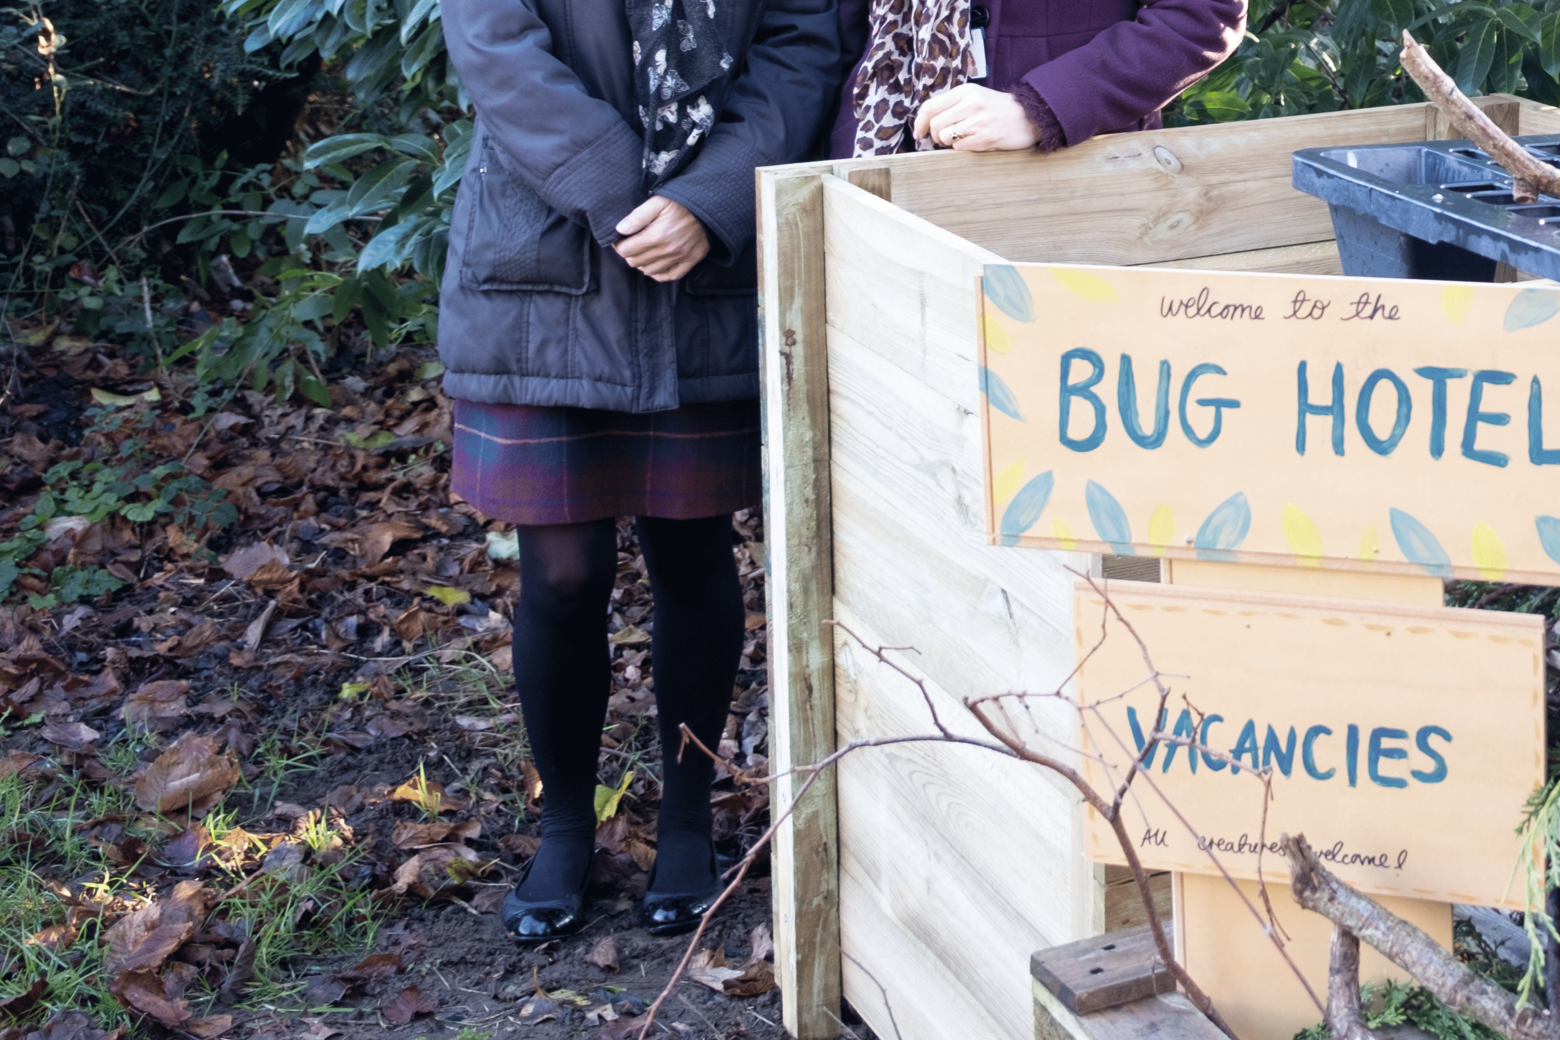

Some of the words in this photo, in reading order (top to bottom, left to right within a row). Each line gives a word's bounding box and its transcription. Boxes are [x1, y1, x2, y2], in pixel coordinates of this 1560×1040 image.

[1160, 287, 1265, 322] welcome
[1283, 290, 1331, 321] to
[1340, 292, 1402, 322] the
[1058, 347, 1241, 453] BUG
[1126, 705, 1454, 788] VACANCIES
[1197, 833, 1287, 857] creatures
